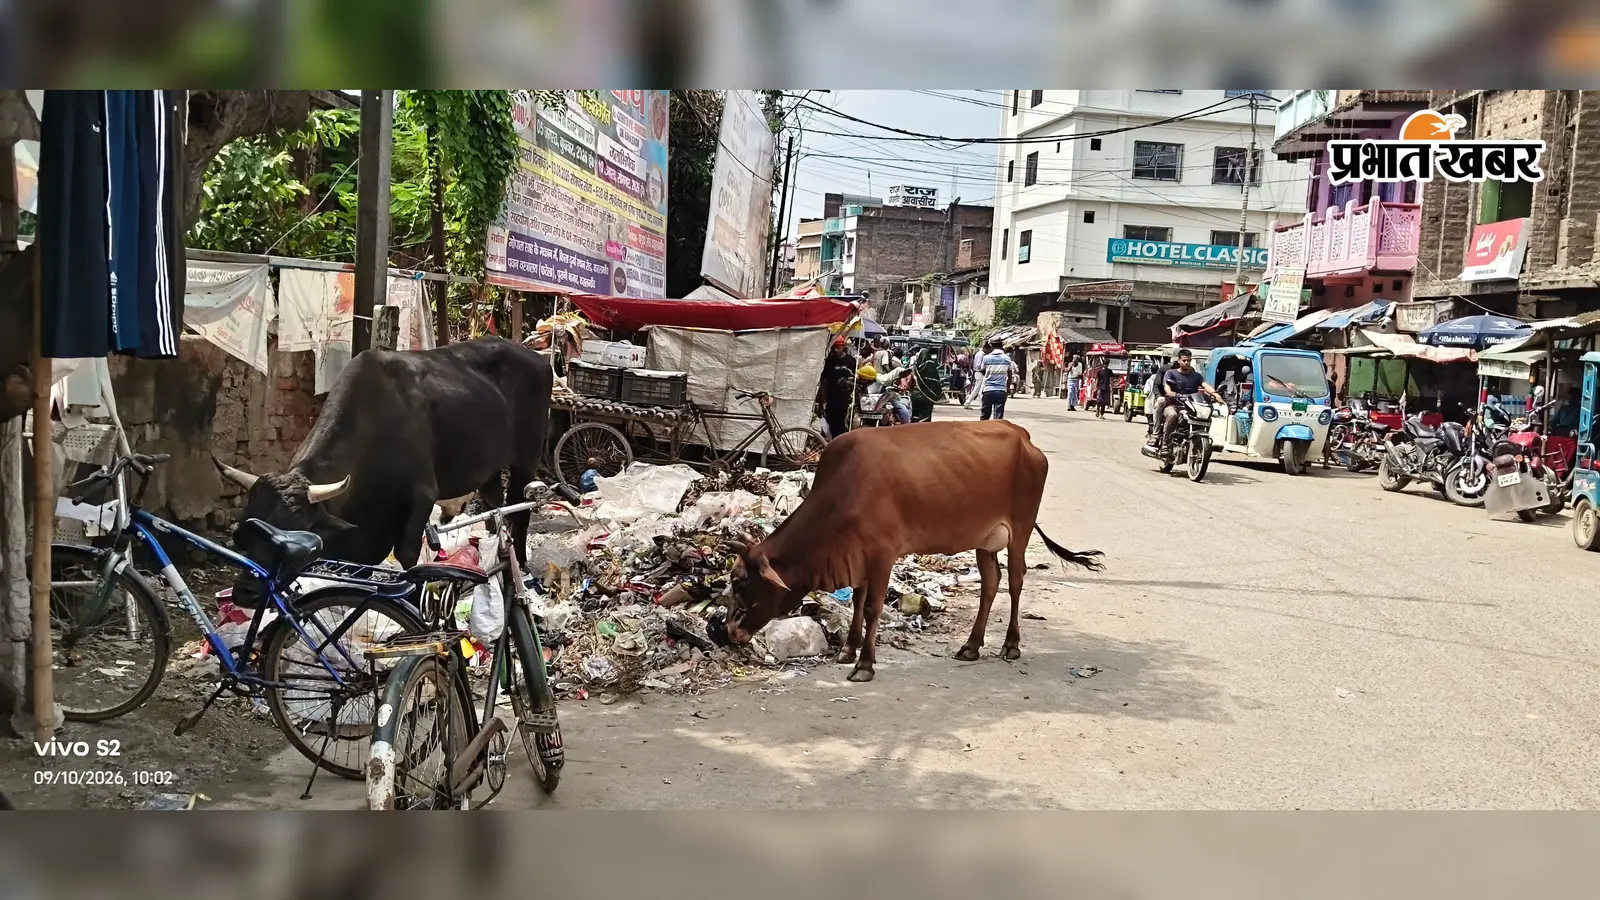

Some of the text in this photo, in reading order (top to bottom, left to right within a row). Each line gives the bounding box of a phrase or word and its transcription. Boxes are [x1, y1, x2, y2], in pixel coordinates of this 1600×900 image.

[904, 186, 937, 196] राज
[902, 196, 936, 206] आवासीय
[1127, 242, 1268, 264] HOTEL CLASSIC
